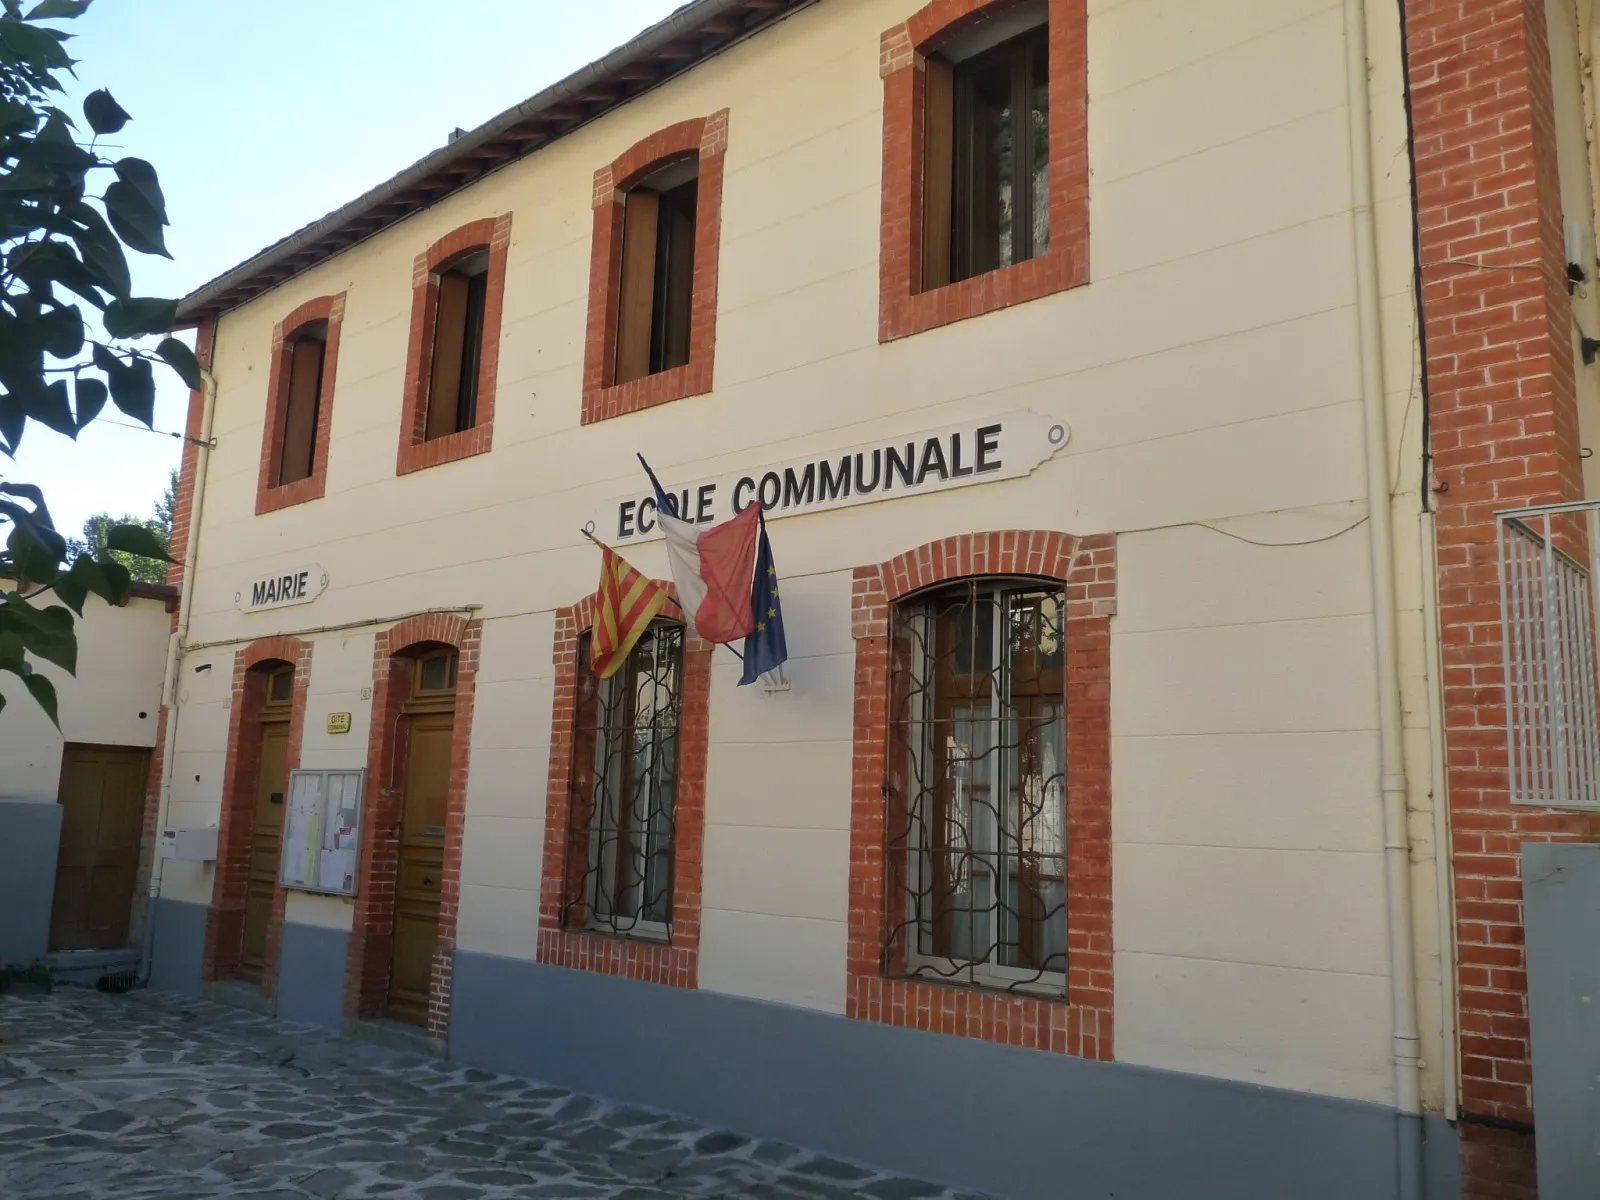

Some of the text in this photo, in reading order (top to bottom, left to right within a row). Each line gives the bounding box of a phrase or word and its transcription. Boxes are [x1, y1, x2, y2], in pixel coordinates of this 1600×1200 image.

[732, 423, 1003, 516] COMMUNALE
[251, 571, 309, 607] MAIRIE
[331, 714, 345, 724] GITE
